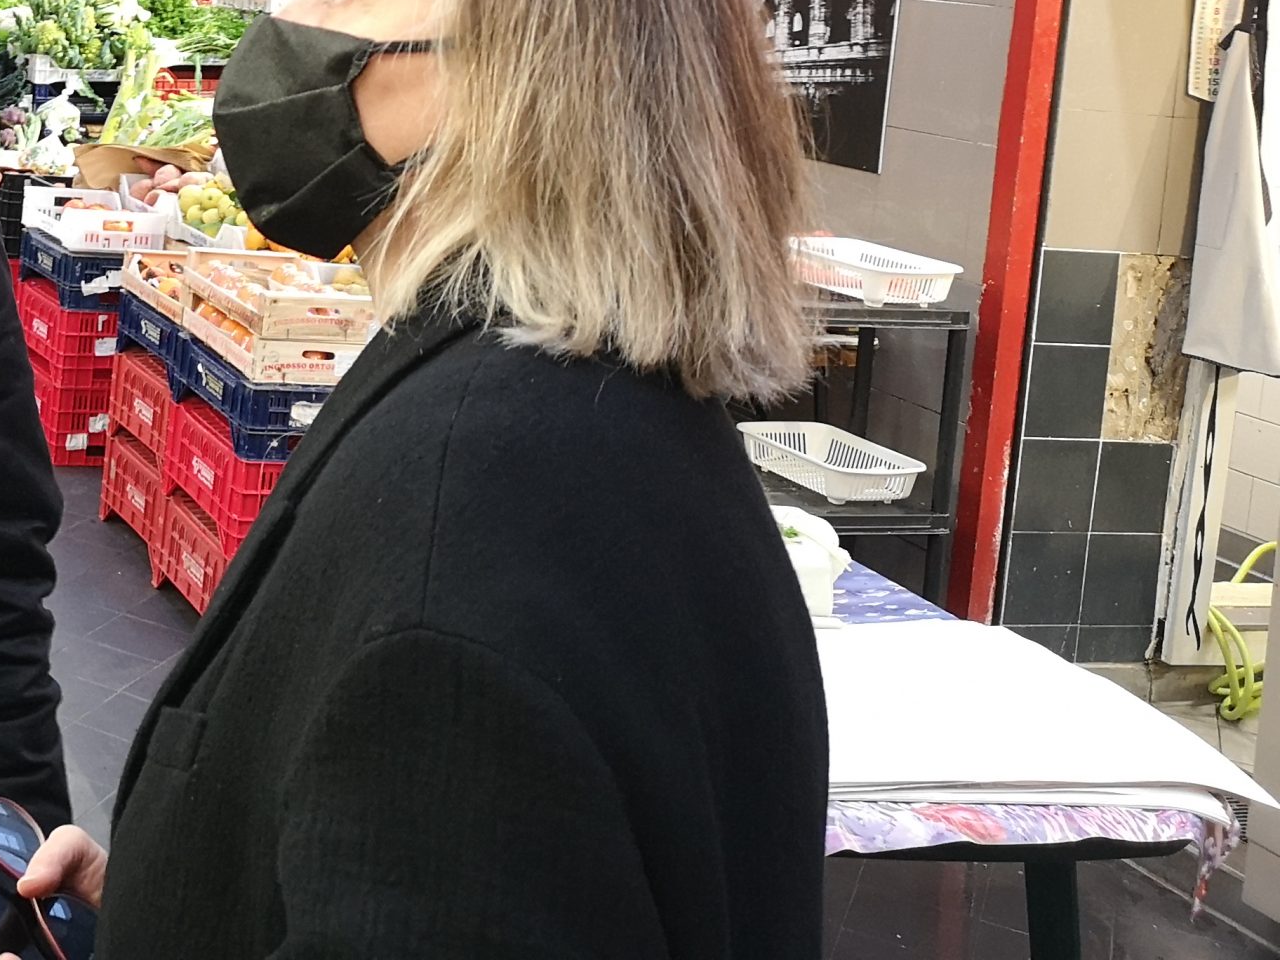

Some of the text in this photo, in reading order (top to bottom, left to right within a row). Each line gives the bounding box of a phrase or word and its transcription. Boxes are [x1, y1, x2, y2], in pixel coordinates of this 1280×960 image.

[1208, 57, 1220, 66] 13
[1208, 68, 1220, 76] 14
[1208, 78, 1220, 86] 15
[1207, 88, 1219, 96] 16
[264, 362, 307, 372] INGROSSO
